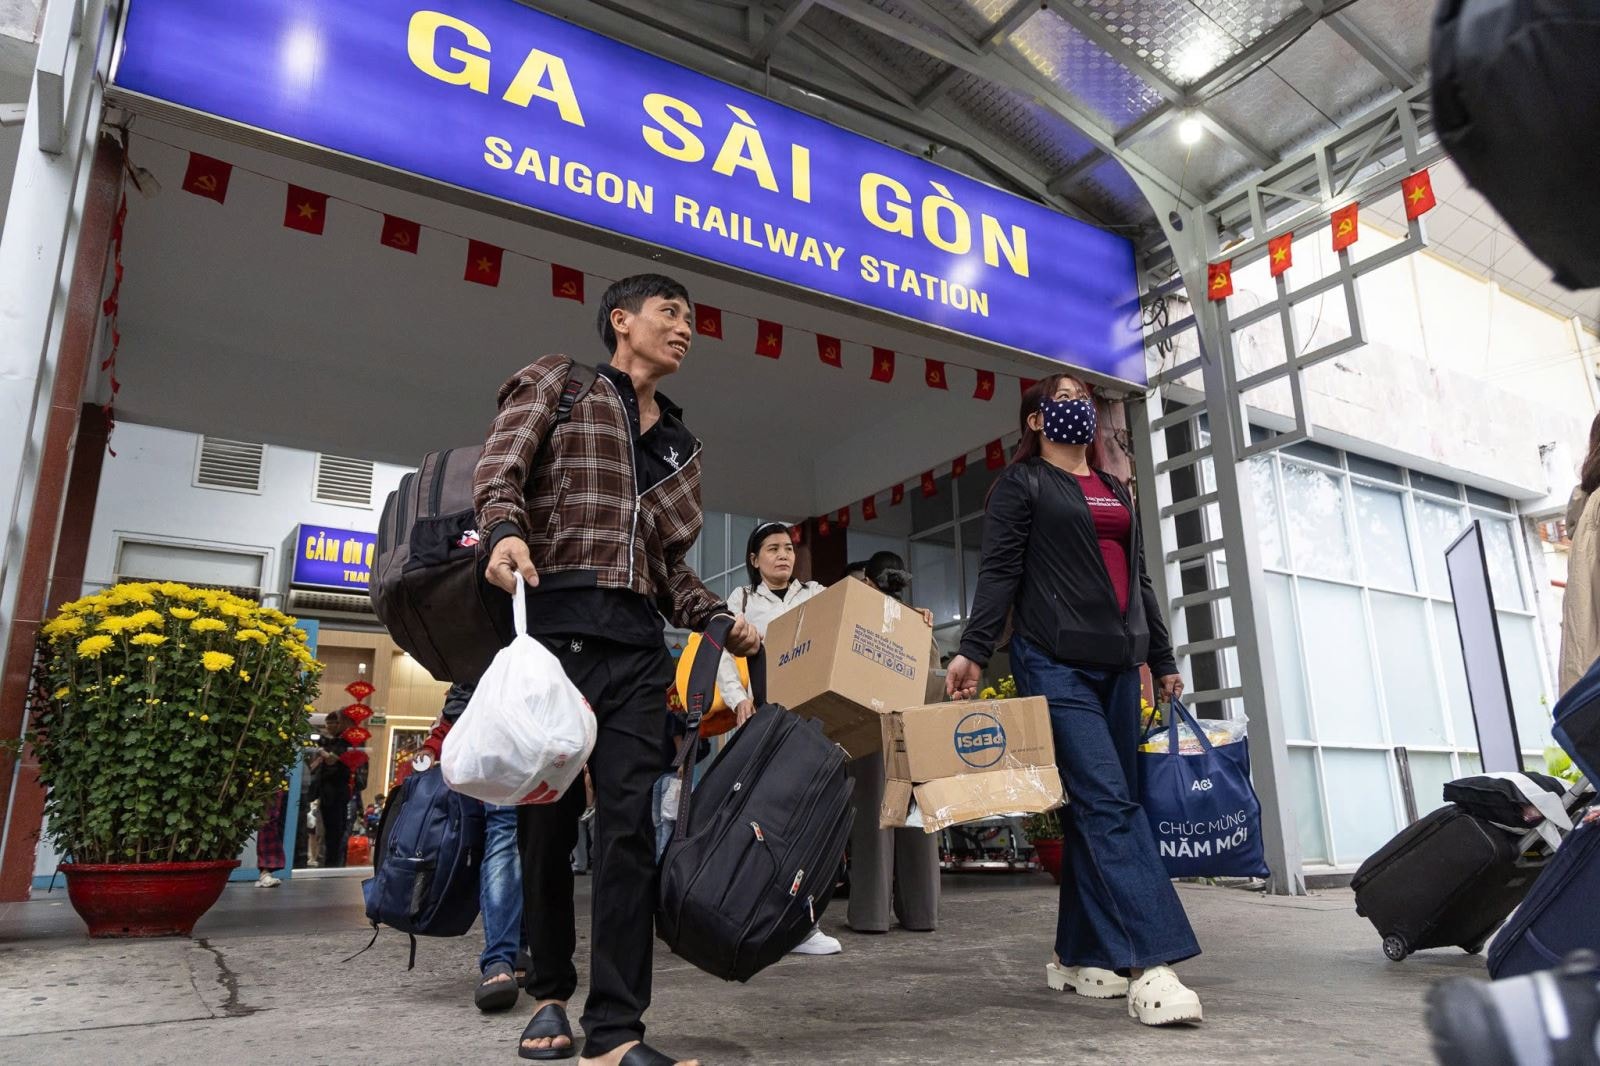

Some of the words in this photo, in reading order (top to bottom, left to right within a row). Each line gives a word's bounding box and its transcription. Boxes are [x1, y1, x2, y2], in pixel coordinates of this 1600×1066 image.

[407, 10, 585, 127] GA
[641, 92, 812, 204] SÀI
[859, 172, 1030, 278] GÒN
[483, 136, 655, 215] SAIGON
[673, 194, 846, 272] RAILWAY
[859, 254, 990, 318] STATION
[305, 531, 340, 562] CẢM
[342, 538, 363, 565] ƠN
[957, 732, 1003, 748] PEPSI
[1191, 778, 1214, 791] ACB
[1158, 820, 1206, 836] CHÚC
[1208, 809, 1246, 834] MỪNG
[1160, 837, 1212, 858] NĂM
[1216, 826, 1248, 854] MỚI
